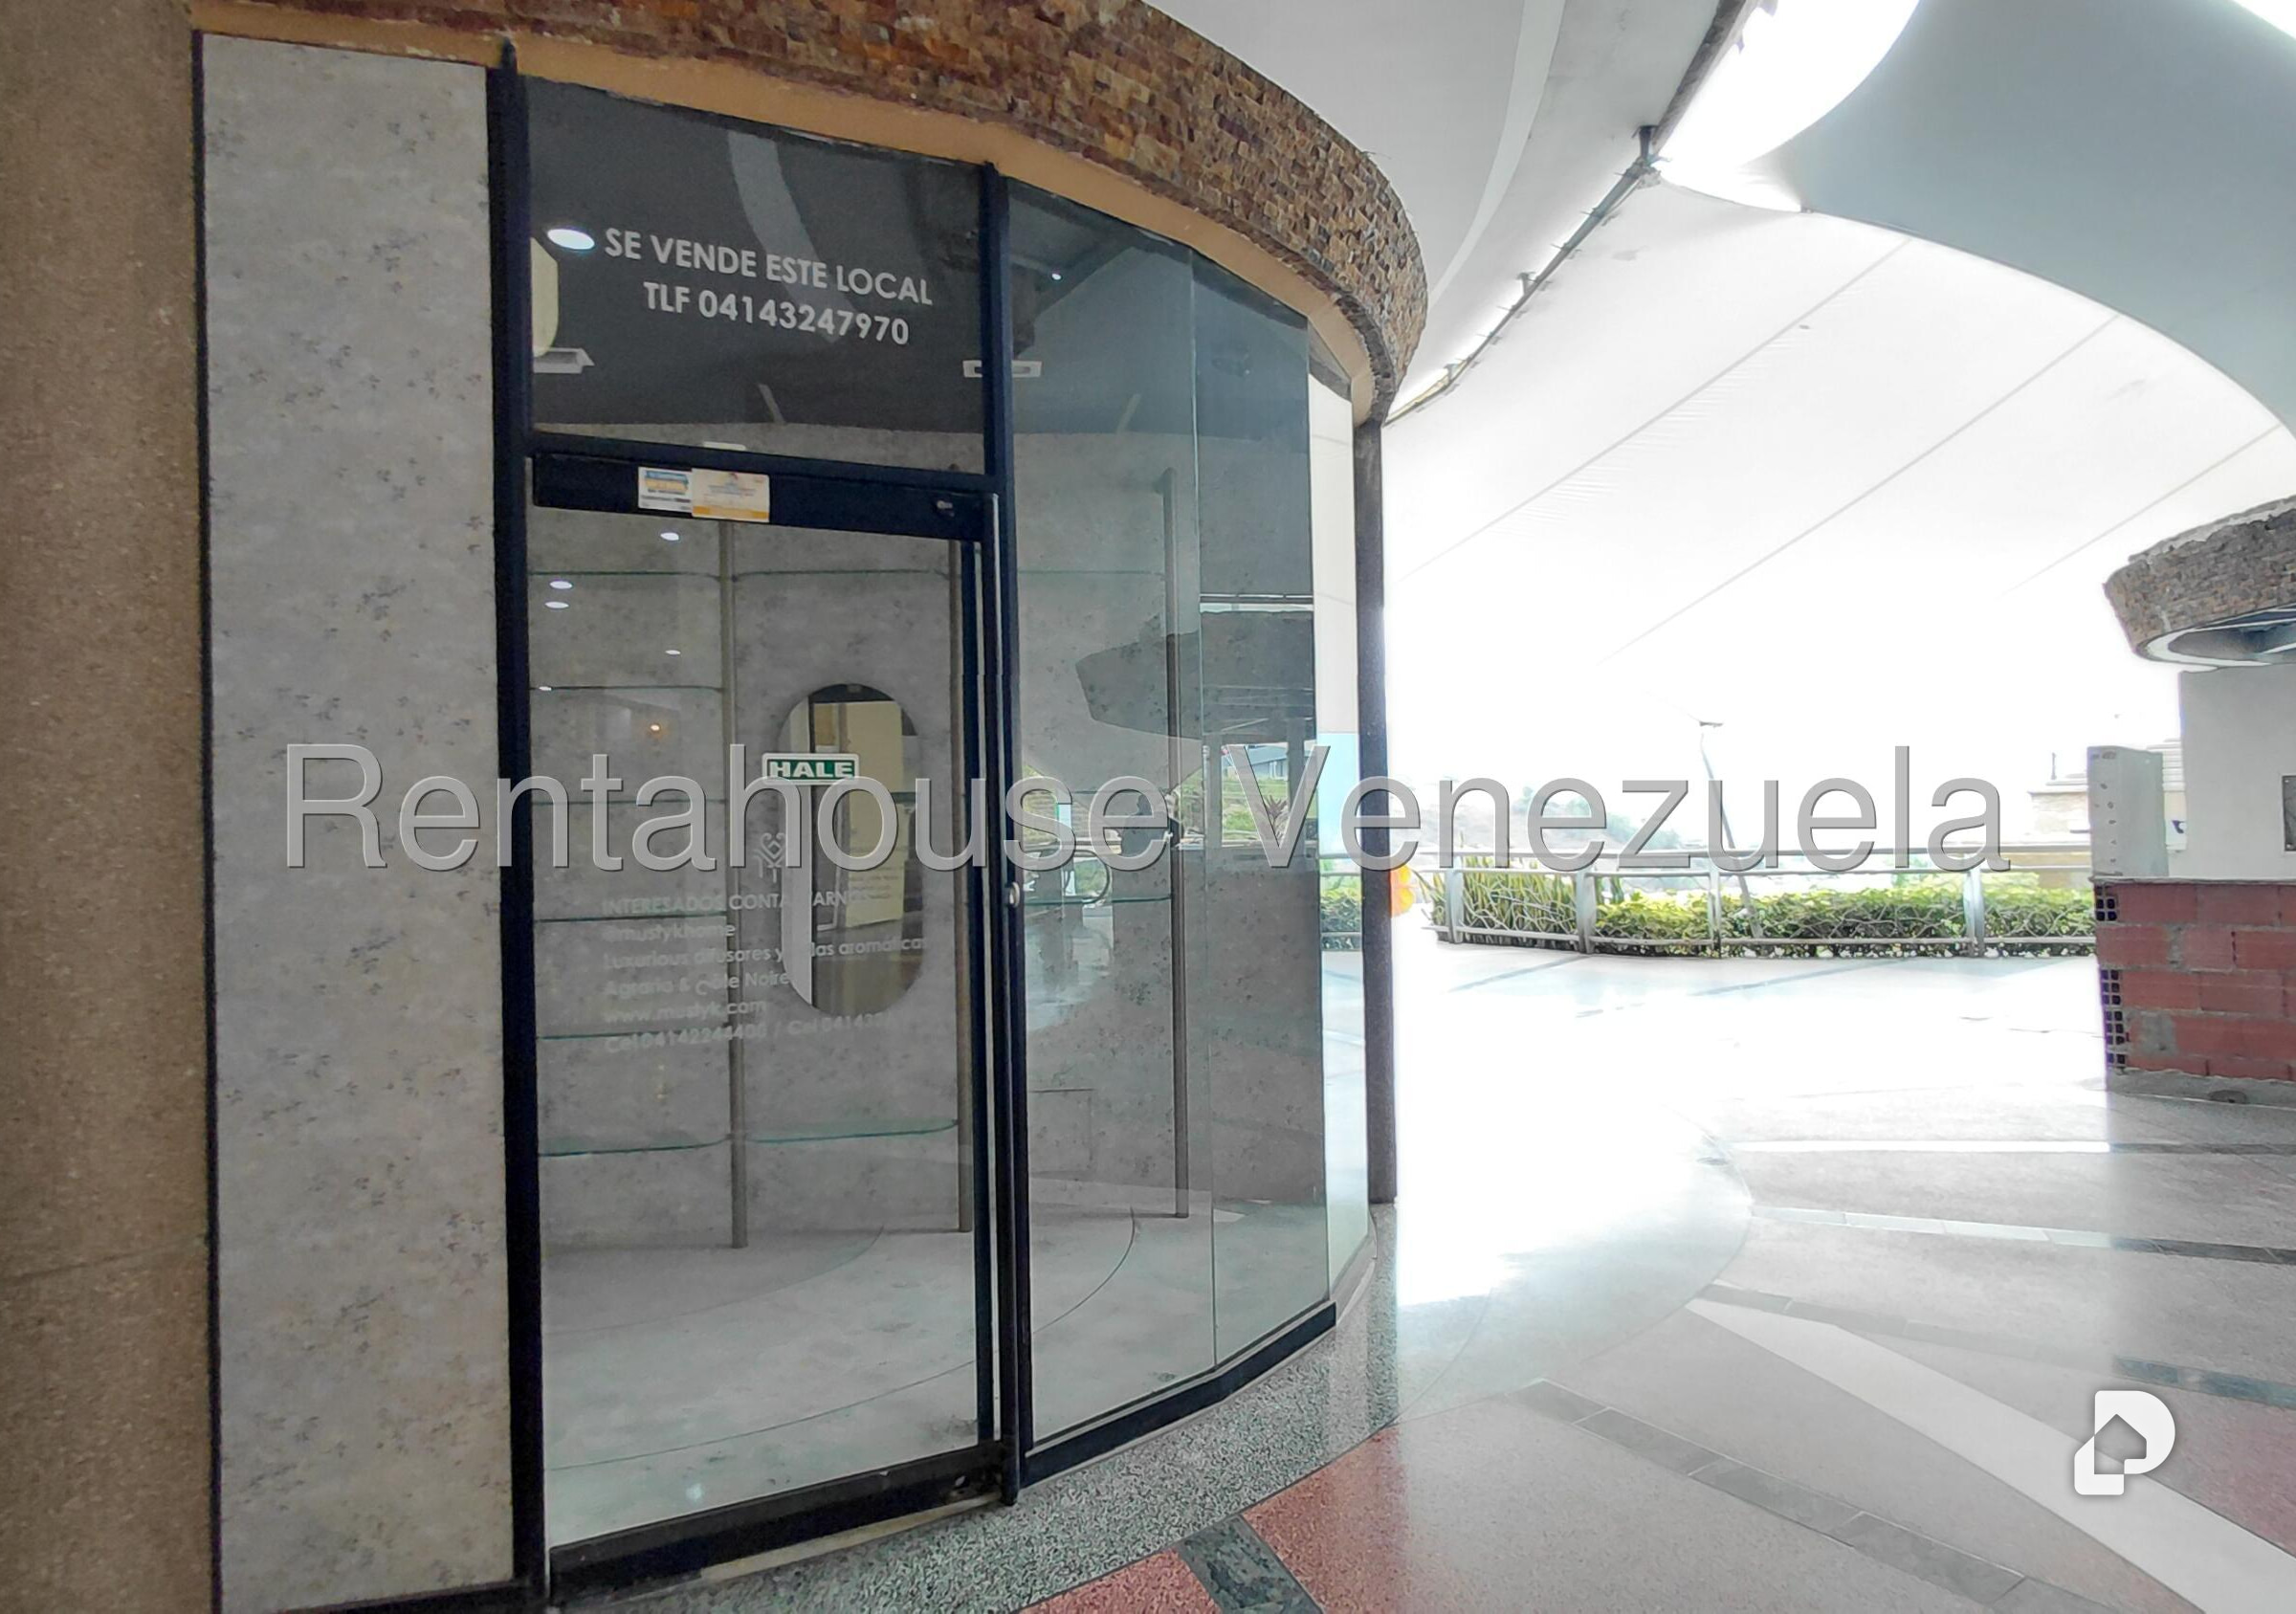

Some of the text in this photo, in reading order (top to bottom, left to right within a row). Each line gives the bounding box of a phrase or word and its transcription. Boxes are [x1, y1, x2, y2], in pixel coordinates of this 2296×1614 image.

[605, 228, 933, 306] SE VENDE ESTE LOCAL
[643, 281, 909, 345] TLF 04143247970
[769, 761, 854, 780] HALE
[602, 894, 727, 914] INTERESADOS
